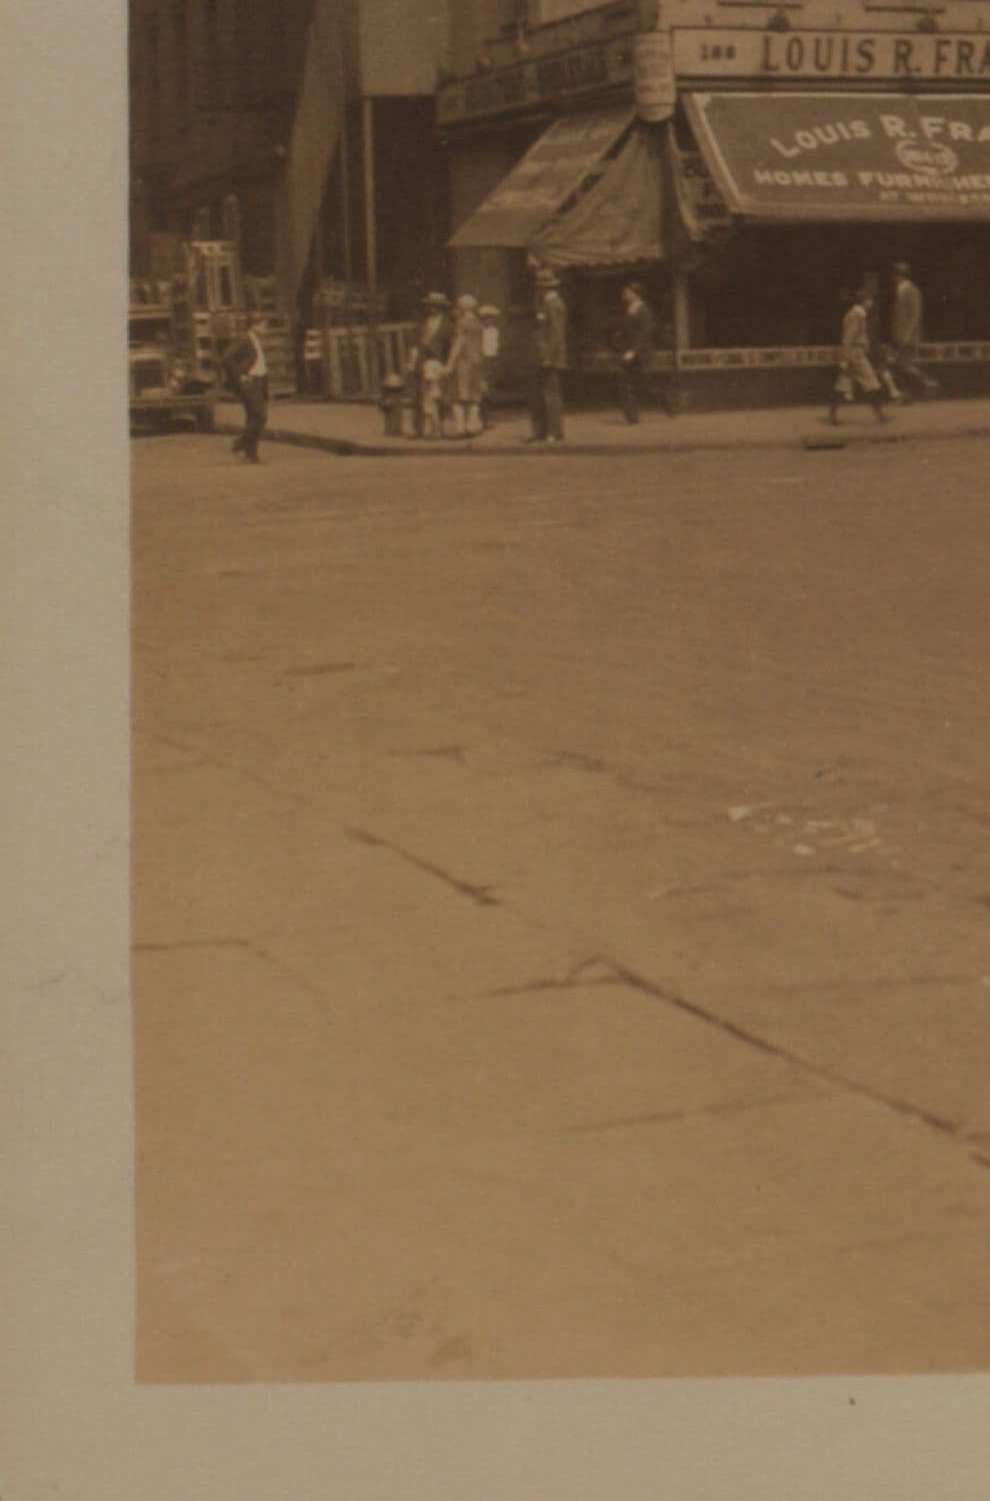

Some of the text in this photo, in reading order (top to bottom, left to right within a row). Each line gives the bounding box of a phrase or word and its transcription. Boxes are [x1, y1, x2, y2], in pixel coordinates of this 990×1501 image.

[758, 36, 876, 74] LOUIS
[892, 38, 922, 75] R.
[769, 121, 873, 159] LOUIS
[879, 113, 917, 140] R.
[753, 169, 849, 188] HOMES
